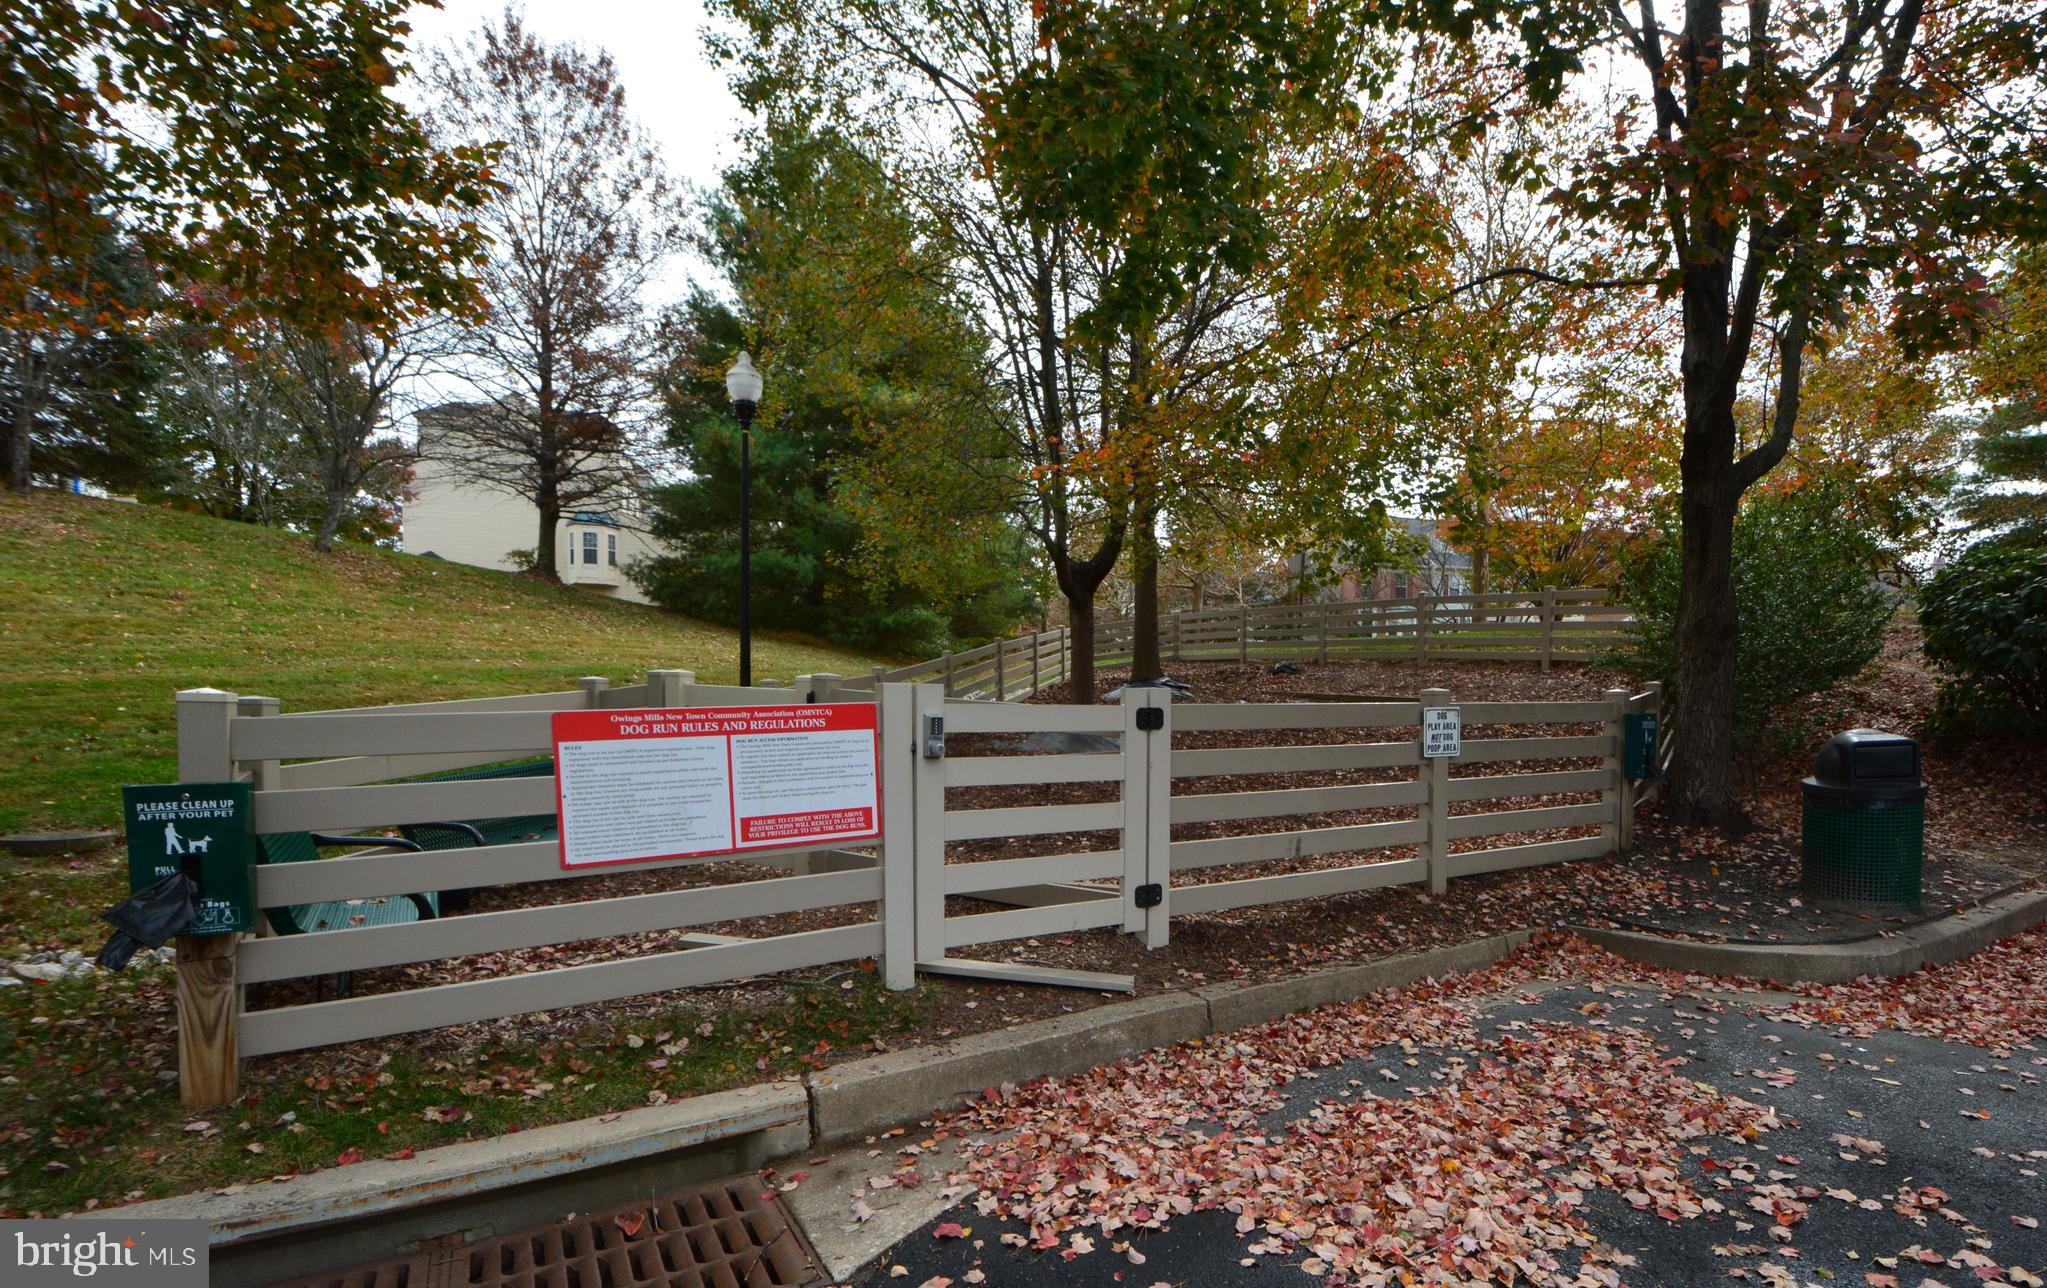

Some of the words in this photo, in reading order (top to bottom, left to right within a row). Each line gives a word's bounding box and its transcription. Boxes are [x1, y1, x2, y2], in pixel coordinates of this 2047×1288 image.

[610, 714, 642, 723] Owings
[644, 713, 664, 721] Mills
[666, 713, 683, 721] New
[685, 712, 706, 720] Town
[708, 711, 751, 720] Community
[753, 710, 794, 718] Association
[796, 708, 833, 717] (OMNTCA)
[1437, 711, 1448, 720] DOG
[620, 724, 649, 735] DOG
[652, 723, 678, 734] RUN
[681, 722, 719, 733] RULES
[721, 720, 747, 731] AND
[750, 718, 826, 730] REGULATIONS
[1427, 722, 1441, 731] PLAY
[1443, 722, 1457, 731] AREA
[1431, 733, 1443, 742] NOT
[1443, 732, 1454, 741] DOG
[1427, 744, 1442, 753] POOP
[1443, 743, 1457, 751] AREA
[136, 801, 179, 812] PLEASE
[181, 800, 217, 810] CLEAN
[219, 799, 234, 808] UP
[138, 812, 176, 821] AFTER
[178, 811, 211, 819] YOUR
[213, 810, 234, 818] PET
[750, 818, 777, 826] FAILURE
[813, 813, 830, 821] WITH
[748, 831, 766, 839] YOUR
[767, 829, 800, 838] PRIVILEGE
[835, 823, 849, 831] DOG
[749, 823, 794, 833] RESTRICTIONS
[811, 819, 833, 827] RESULT
[154, 865, 176, 873] PULL
[207, 901, 231, 909] Bags
